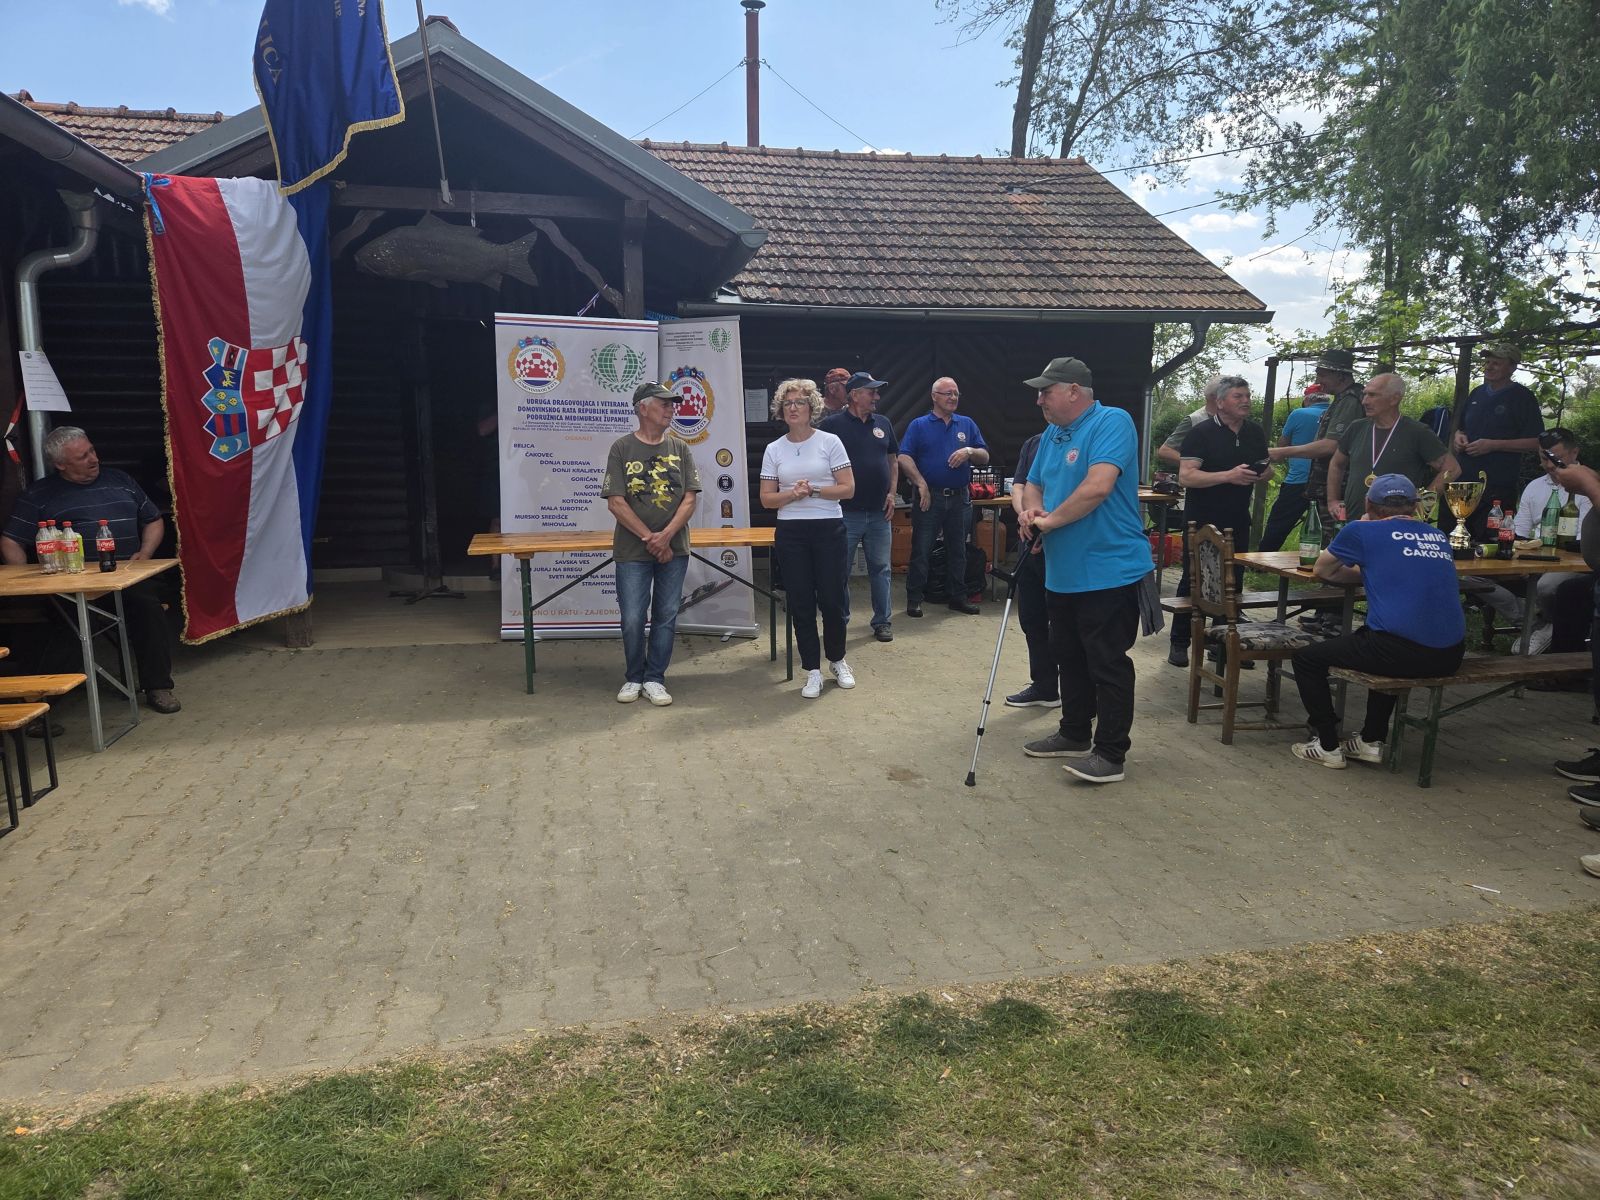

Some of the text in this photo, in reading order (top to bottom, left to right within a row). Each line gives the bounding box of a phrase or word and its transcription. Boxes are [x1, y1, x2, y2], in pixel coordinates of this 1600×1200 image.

[552, 399, 596, 407] DRAGOVOLJACA
[603, 415, 629, 424] ŽUPANIJE
[1391, 531, 1446, 543] COLMIC
[1417, 541, 1440, 551] ŠRD
